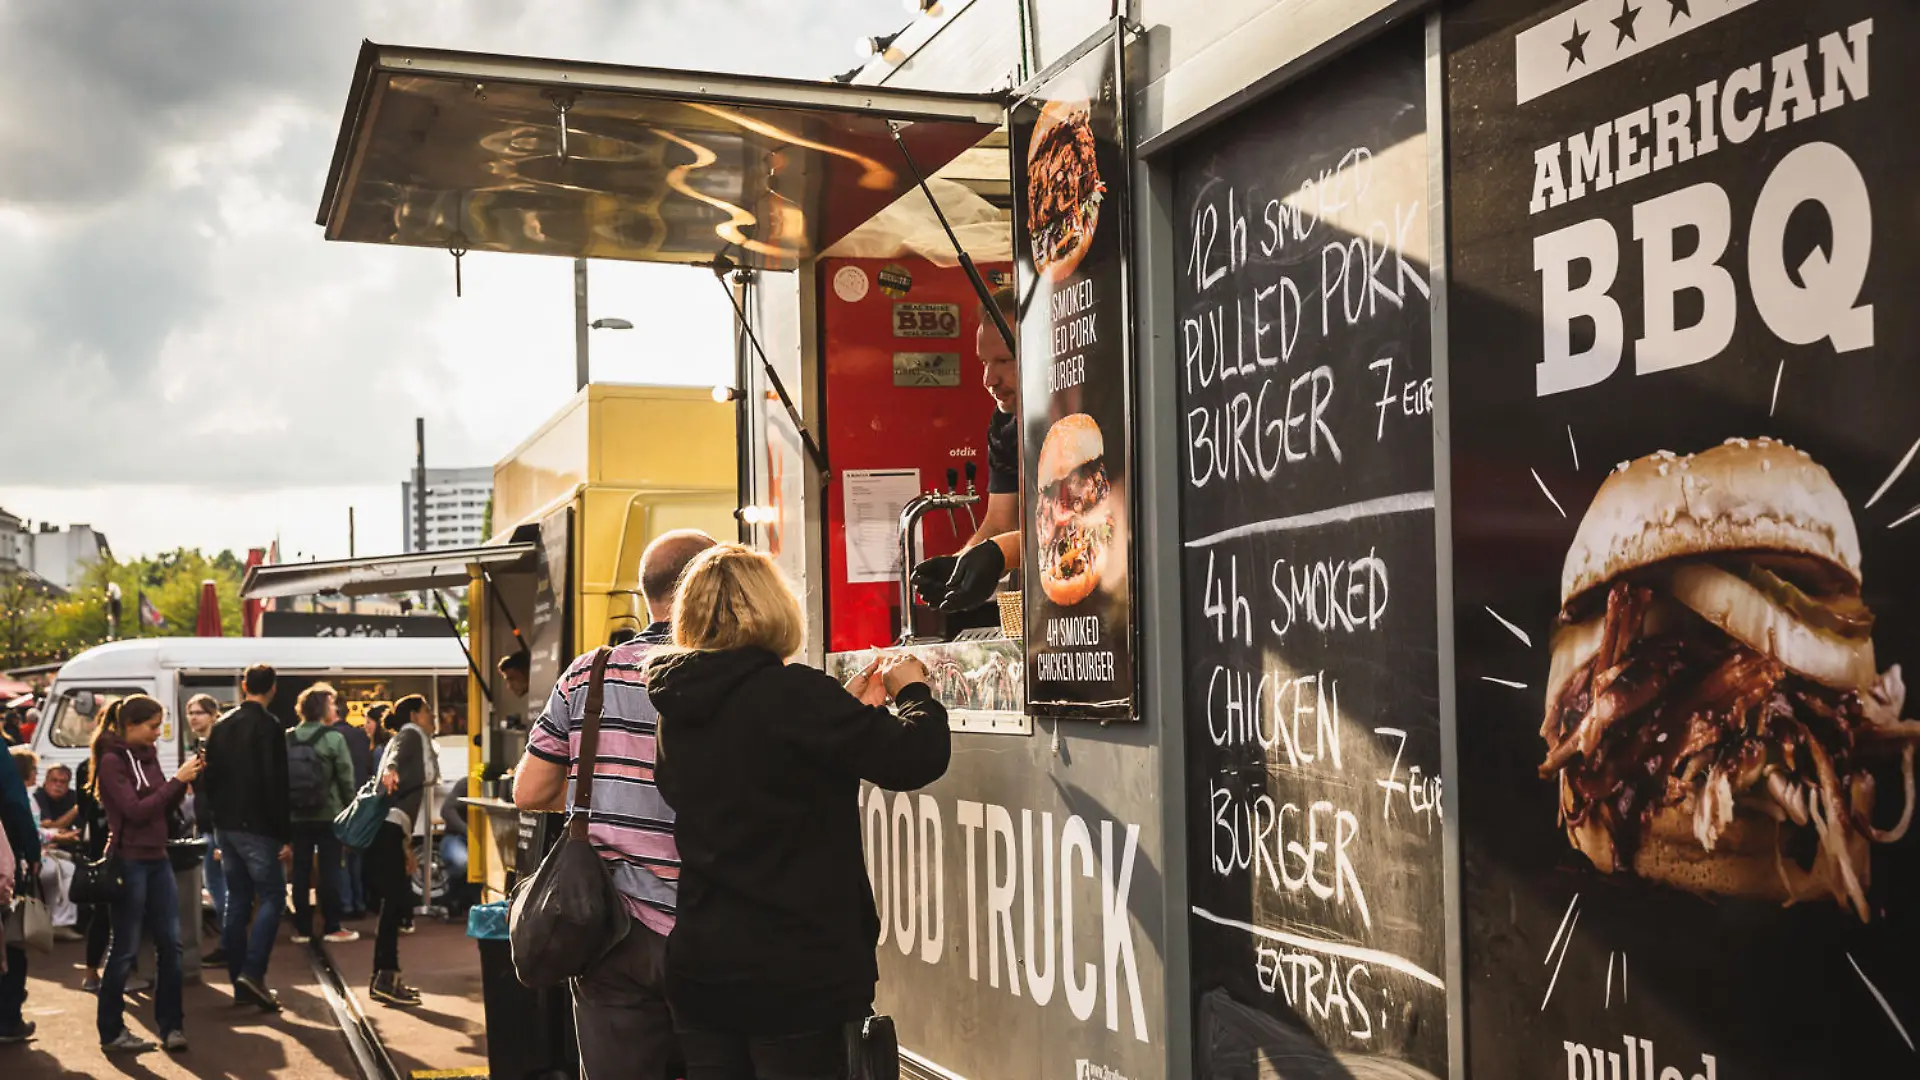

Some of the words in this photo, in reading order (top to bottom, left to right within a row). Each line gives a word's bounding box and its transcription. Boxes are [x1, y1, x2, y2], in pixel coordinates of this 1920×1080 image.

[1529, 18, 1874, 215] AMERICAN
[1260, 146, 1373, 257] SMOKED
[1052, 278, 1093, 322] SMOKED
[1184, 276, 1301, 394] PULLED
[1321, 200, 1431, 336] PORK
[1533, 141, 1875, 398] BBQ
[896, 311, 957, 334] BBQ
[1070, 312, 1097, 352] PORK
[1048, 354, 1085, 394] BURGER
[1187, 365, 1342, 488] BURGER
[1368, 357, 1396, 442] 7
[1046, 618, 1058, 647] 4H
[1060, 616, 1099, 646] SMOKED
[1202, 549, 1252, 647] 4h
[1270, 546, 1390, 637] SMOKED
[1037, 652, 1075, 681] CHICKEN
[1076, 651, 1115, 681] BURGER
[1207, 665, 1342, 769] CHICKEN
[1209, 779, 1372, 930] BURGER
[1373, 727, 1407, 821] 7
[858, 785, 944, 965] OOD
[956, 799, 1149, 1043] TRUCK
[1563, 1034, 1717, 1080] pull
